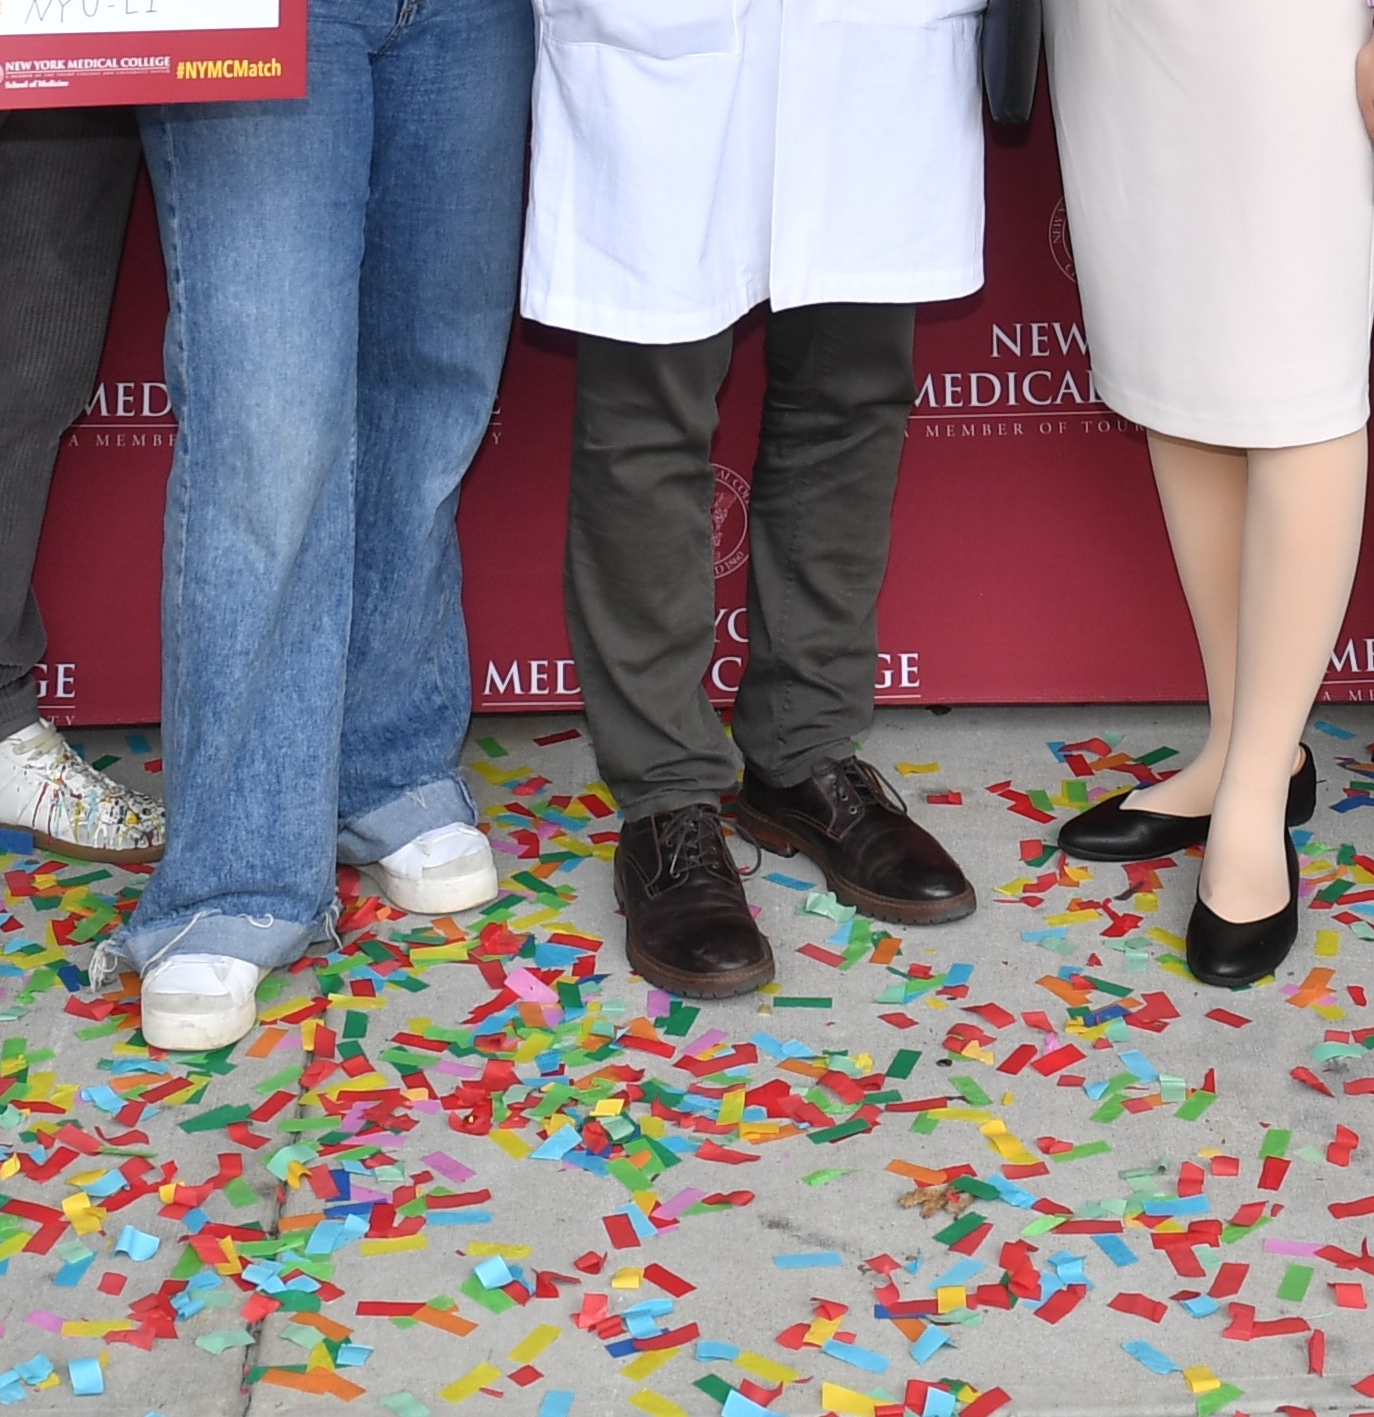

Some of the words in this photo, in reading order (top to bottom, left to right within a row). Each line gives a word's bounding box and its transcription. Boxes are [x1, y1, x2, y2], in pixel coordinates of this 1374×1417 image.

[5, 61, 31, 71] NEW
[33, 60, 66, 70] YORK
[67, 58, 117, 69] MEDICAL
[120, 56, 171, 67] COLLEGE
[177, 60, 282, 78] #NYMCMatch
[926, 423, 1023, 437] MEMBER
[1039, 421, 1066, 434] OF
